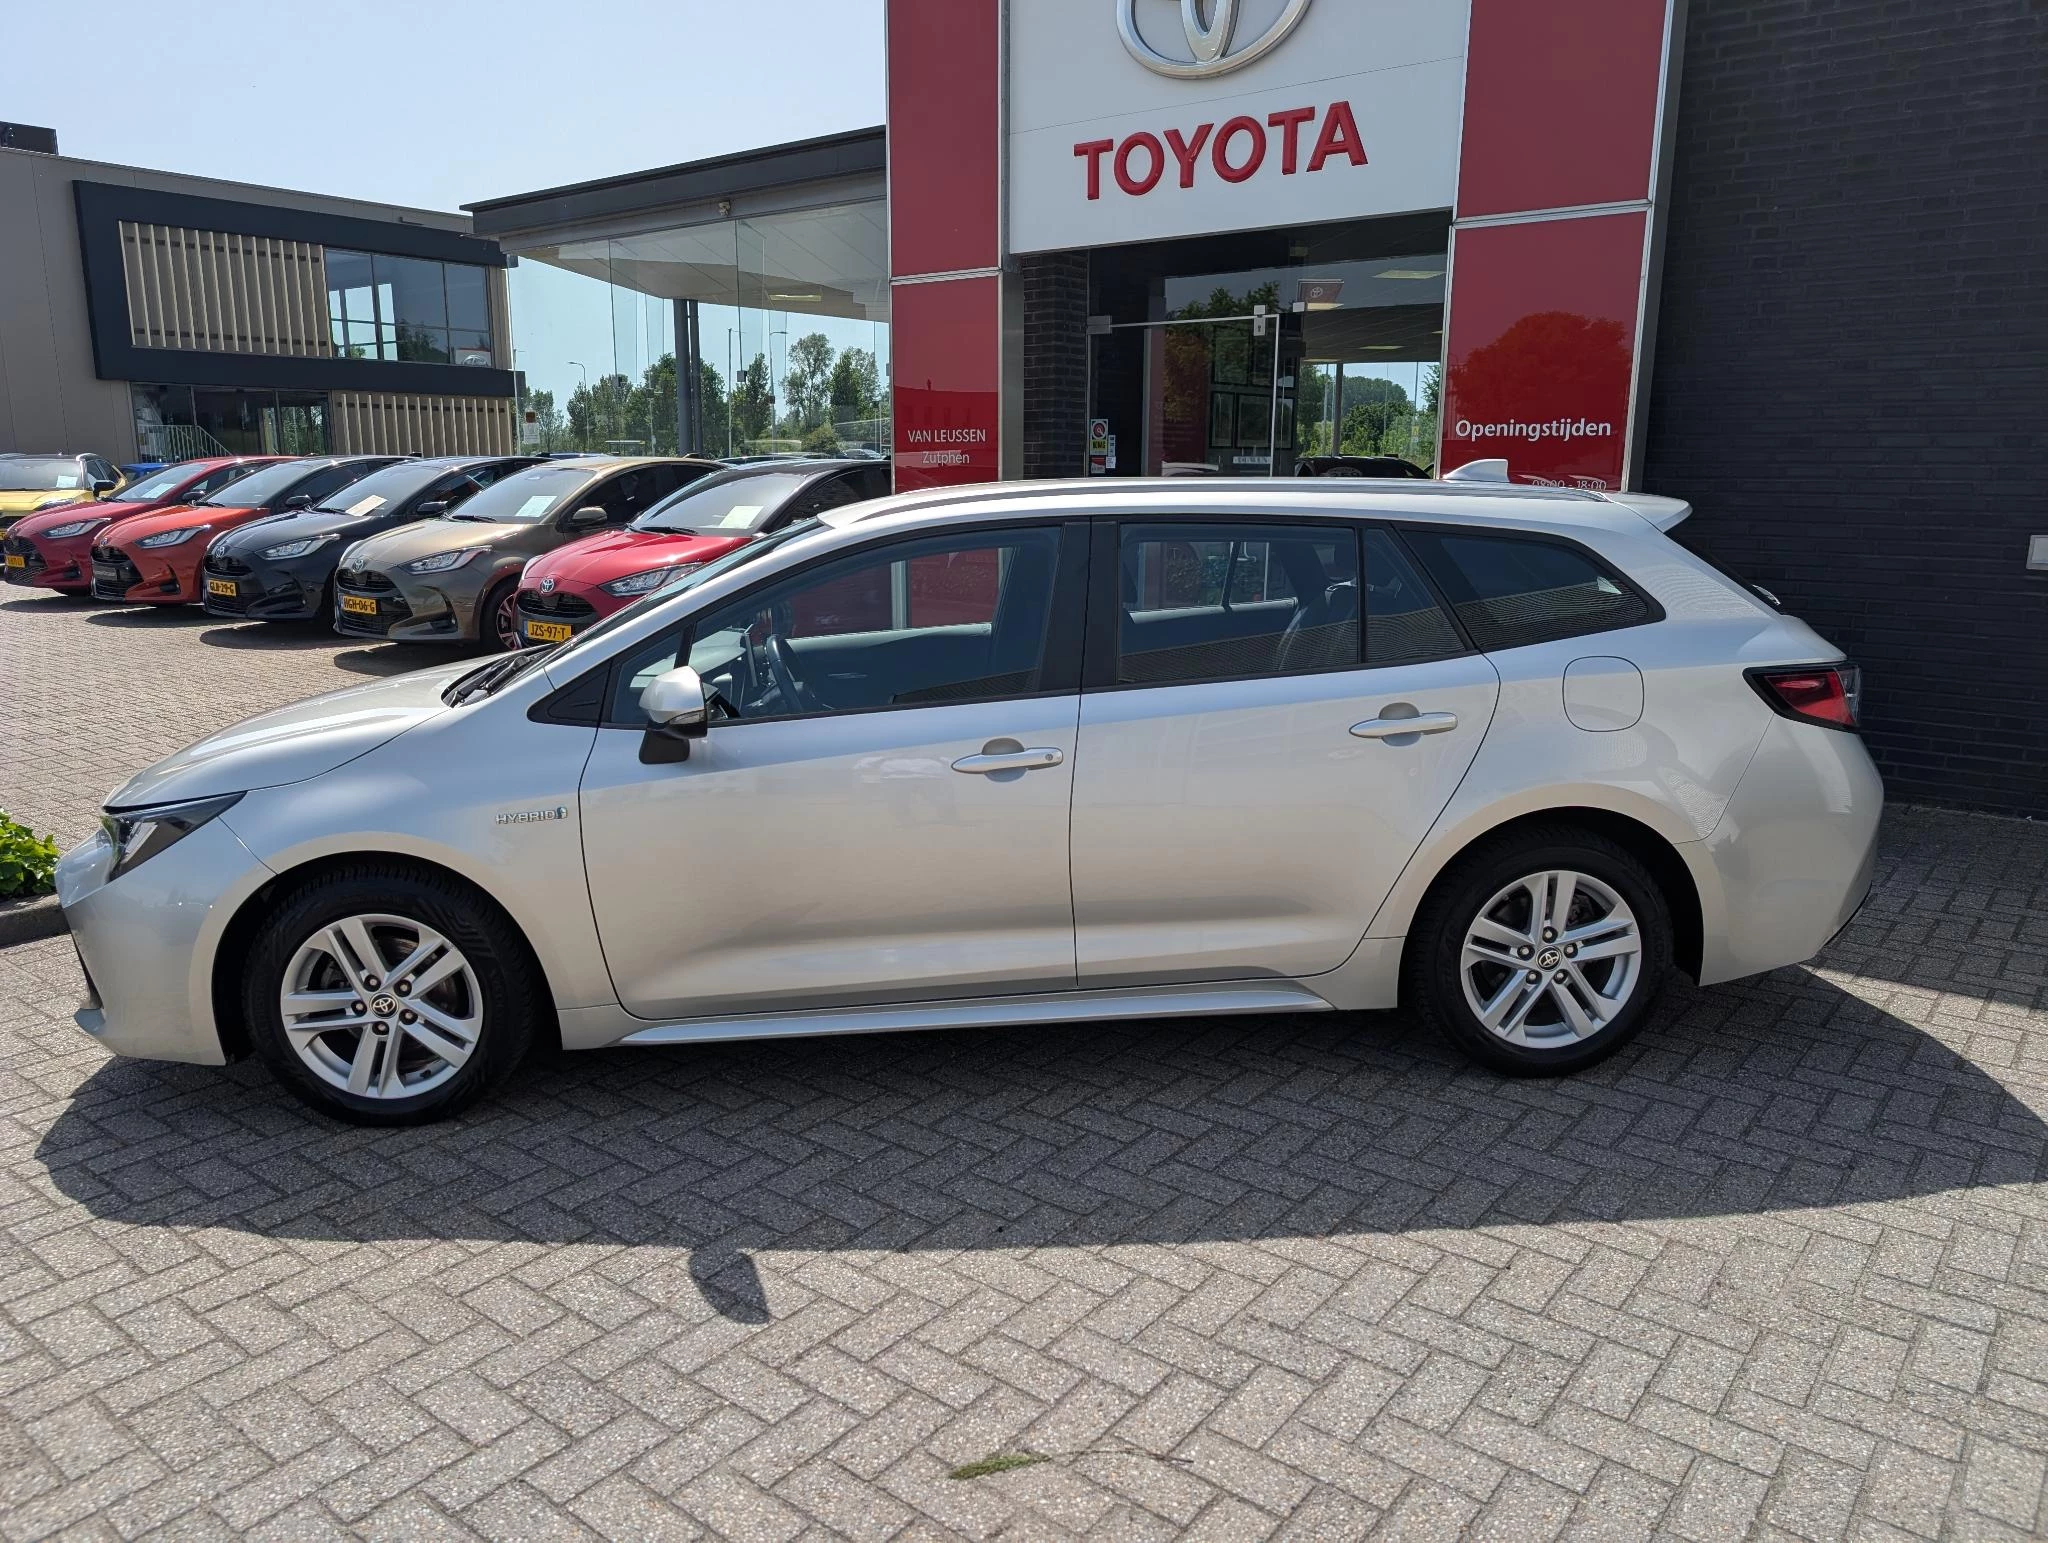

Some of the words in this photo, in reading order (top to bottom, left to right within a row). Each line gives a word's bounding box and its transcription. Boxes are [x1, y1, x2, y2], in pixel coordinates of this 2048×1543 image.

[1073, 100, 1369, 200] TOYOTA
[908, 429, 931, 442] VAN
[934, 429, 986, 442] LEUSSEN
[1455, 418, 1611, 442] Openingstijden
[922, 451, 970, 467] Zutphen
[530, 623, 566, 640] JZS-97-T
[495, 809, 557, 825] HYBRID
